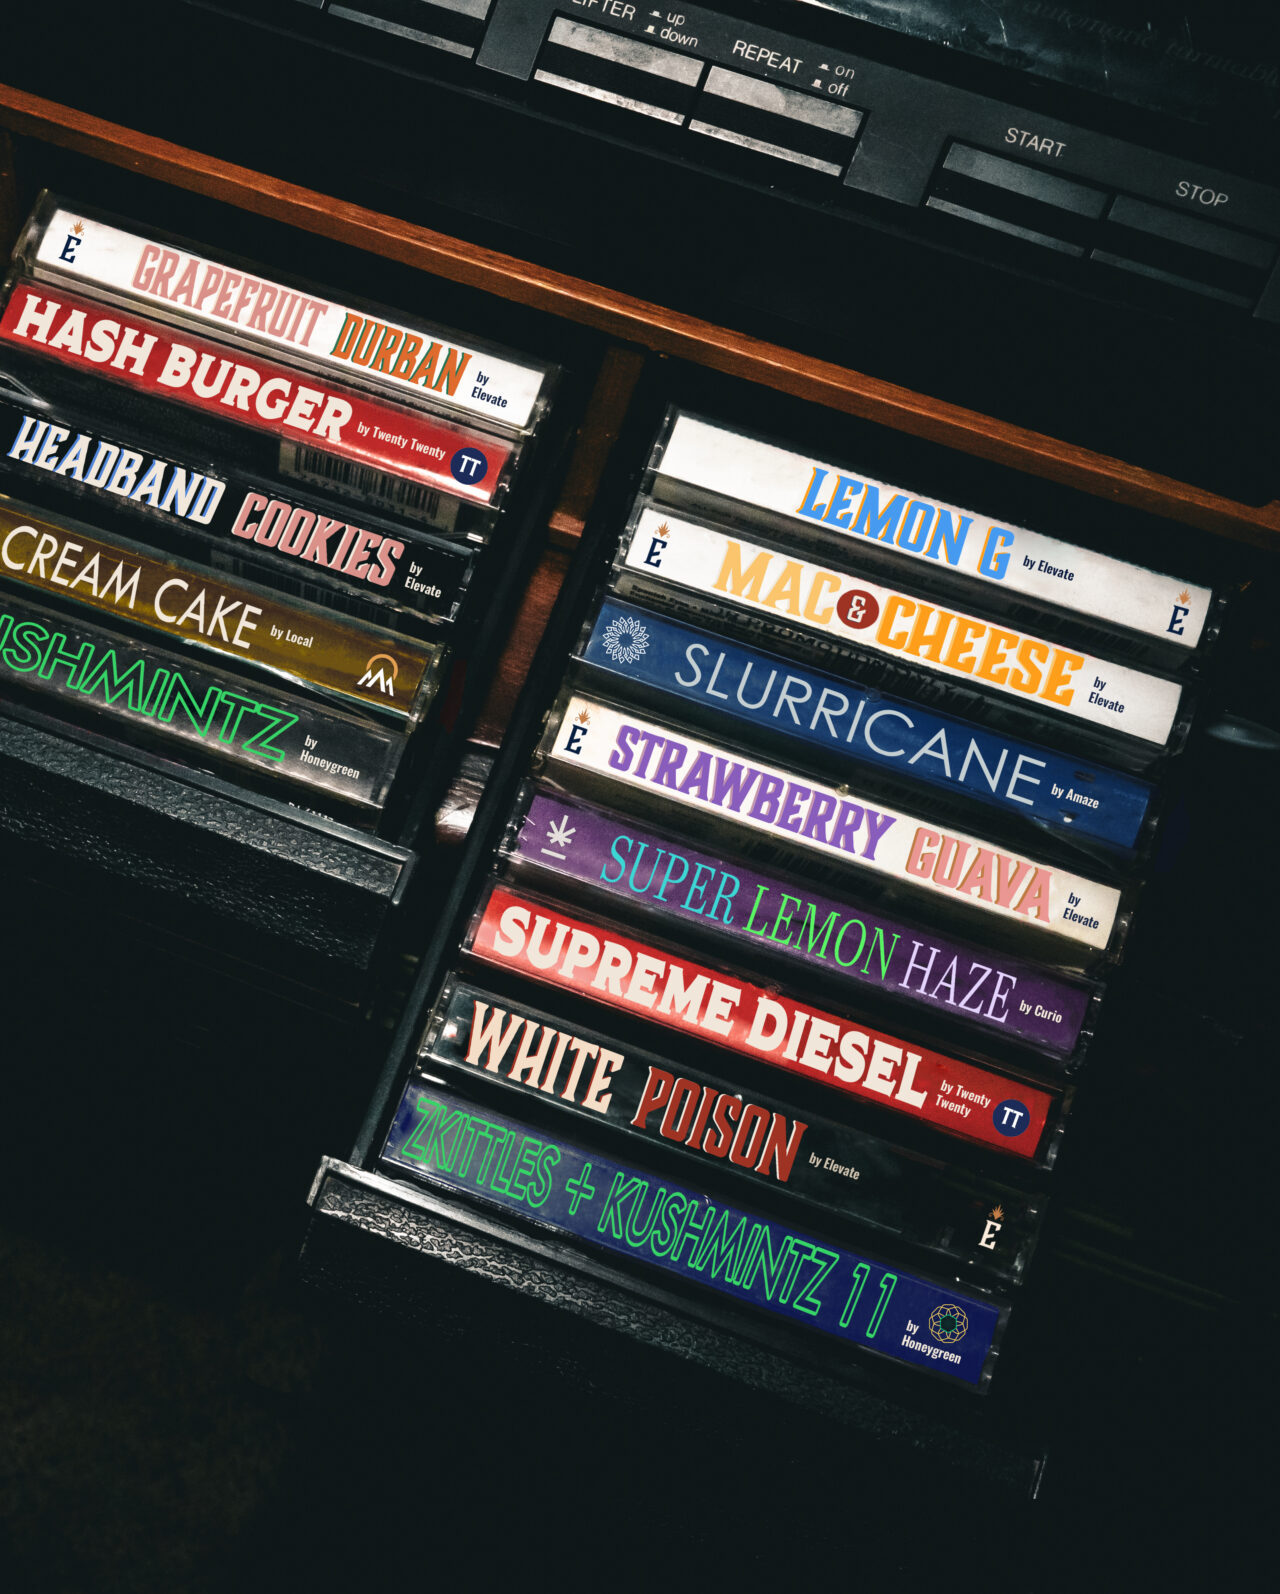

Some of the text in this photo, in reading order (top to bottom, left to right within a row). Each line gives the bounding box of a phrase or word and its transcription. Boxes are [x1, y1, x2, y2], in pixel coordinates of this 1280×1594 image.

[667, 12, 685, 26] up
[660, 26, 698, 48] down
[732, 40, 803, 74] REPEAT
[835, 65, 855, 79] on
[828, 82, 850, 97] off
[1004, 128, 1067, 158] START
[1176, 181, 1229, 208] STOP
[59, 234, 82, 263] E
[131, 244, 472, 397] GRAPEFRUIT DURBAN
[12, 293, 447, 460] HASH BURGER by Twenty Twenty
[477, 371, 490, 386] by
[470, 385, 507, 408] Elevate
[459, 455, 482, 477] TT
[6, 415, 228, 526] HEADBAND
[231, 492, 405, 588] COOKIES
[796, 466, 974, 567] LEMON
[978, 525, 1014, 580] G
[1023, 554, 1037, 571] by
[1038, 559, 1074, 582] Elevate
[644, 536, 668, 568] E
[410, 561, 424, 577] by
[1, 526, 143, 611] CREAM
[154, 578, 263, 649] CAKE
[270, 624, 284, 640] by
[285, 628, 314, 648] Local
[404, 576, 442, 598] Elevate
[712, 540, 1084, 707] MAC & CHEESE
[1166, 604, 1188, 636] E
[1094, 676, 1107, 692] by
[1088, 690, 1124, 714] Elevate
[564, 724, 588, 755] E
[674, 643, 1100, 809] SLURRICANE by Amaze
[304, 735, 318, 751] by
[300, 749, 360, 780] Honeygreen
[608, 724, 1054, 924] STRAWBERRY GUAVA
[1068, 892, 1081, 908] by
[600, 834, 1062, 1024] SUPER LEMON HAZE by Curio
[1062, 906, 1099, 930] Elevate
[492, 905, 928, 1109] SUPREME DIESEL
[465, 1000, 860, 1182] WHITE POISON by Elevate
[940, 1078, 991, 1108] by Twenty
[935, 1094, 972, 1119] Twenty
[1001, 1106, 1023, 1129] TT
[401, 1096, 560, 1208] ZKITTLES
[598, 1170, 839, 1317] KUSHMINTZ
[838, 1263, 897, 1339] 11
[978, 1219, 1001, 1250] E
[907, 1319, 920, 1335] by
[901, 1333, 961, 1366] Honeygreen
